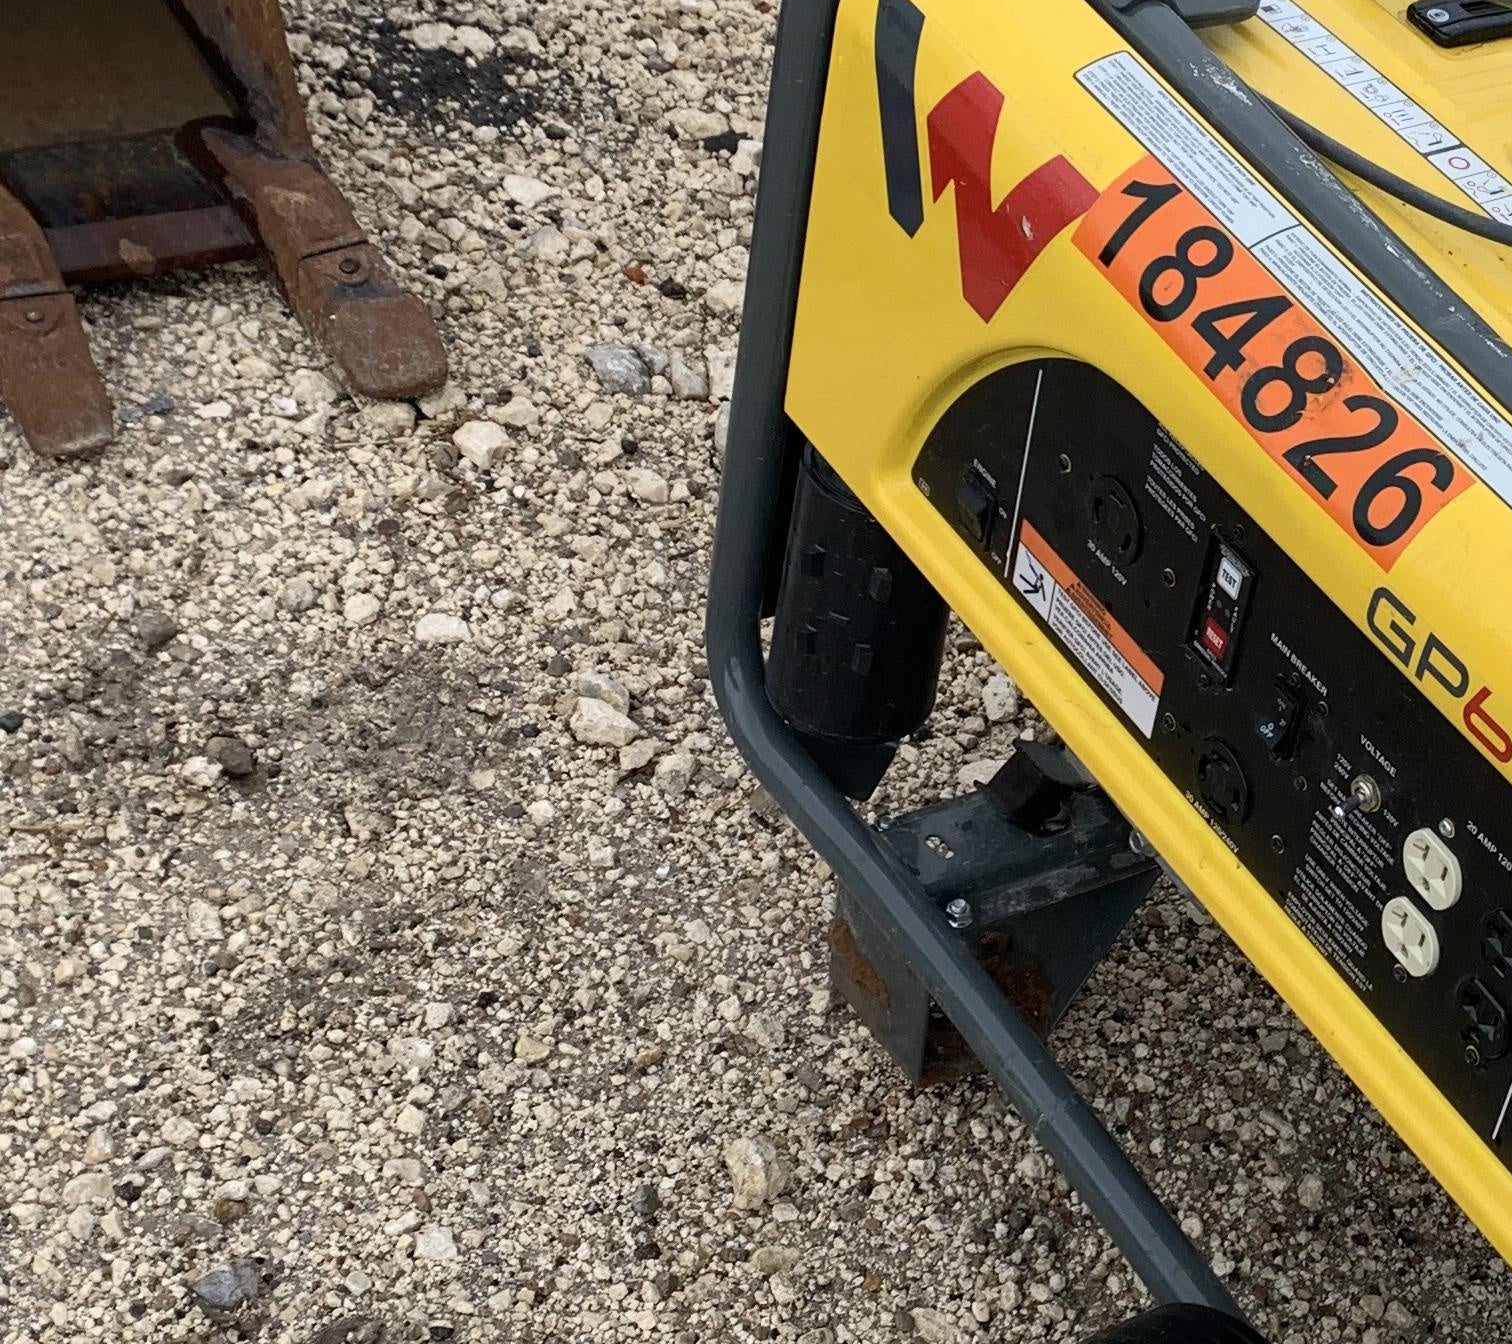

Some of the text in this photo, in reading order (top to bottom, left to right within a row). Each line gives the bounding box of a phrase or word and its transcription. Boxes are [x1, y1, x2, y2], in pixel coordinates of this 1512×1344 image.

[1099, 180, 1457, 548] 184826
[1222, 568, 1237, 589] TEST
[1206, 626, 1224, 649] RESET
[1270, 632, 1328, 697] MAIN BREAKER
[1361, 734, 1397, 778] VOLTAGE
[1465, 820, 1478, 836] 20
[1477, 833, 1497, 854] AMP
